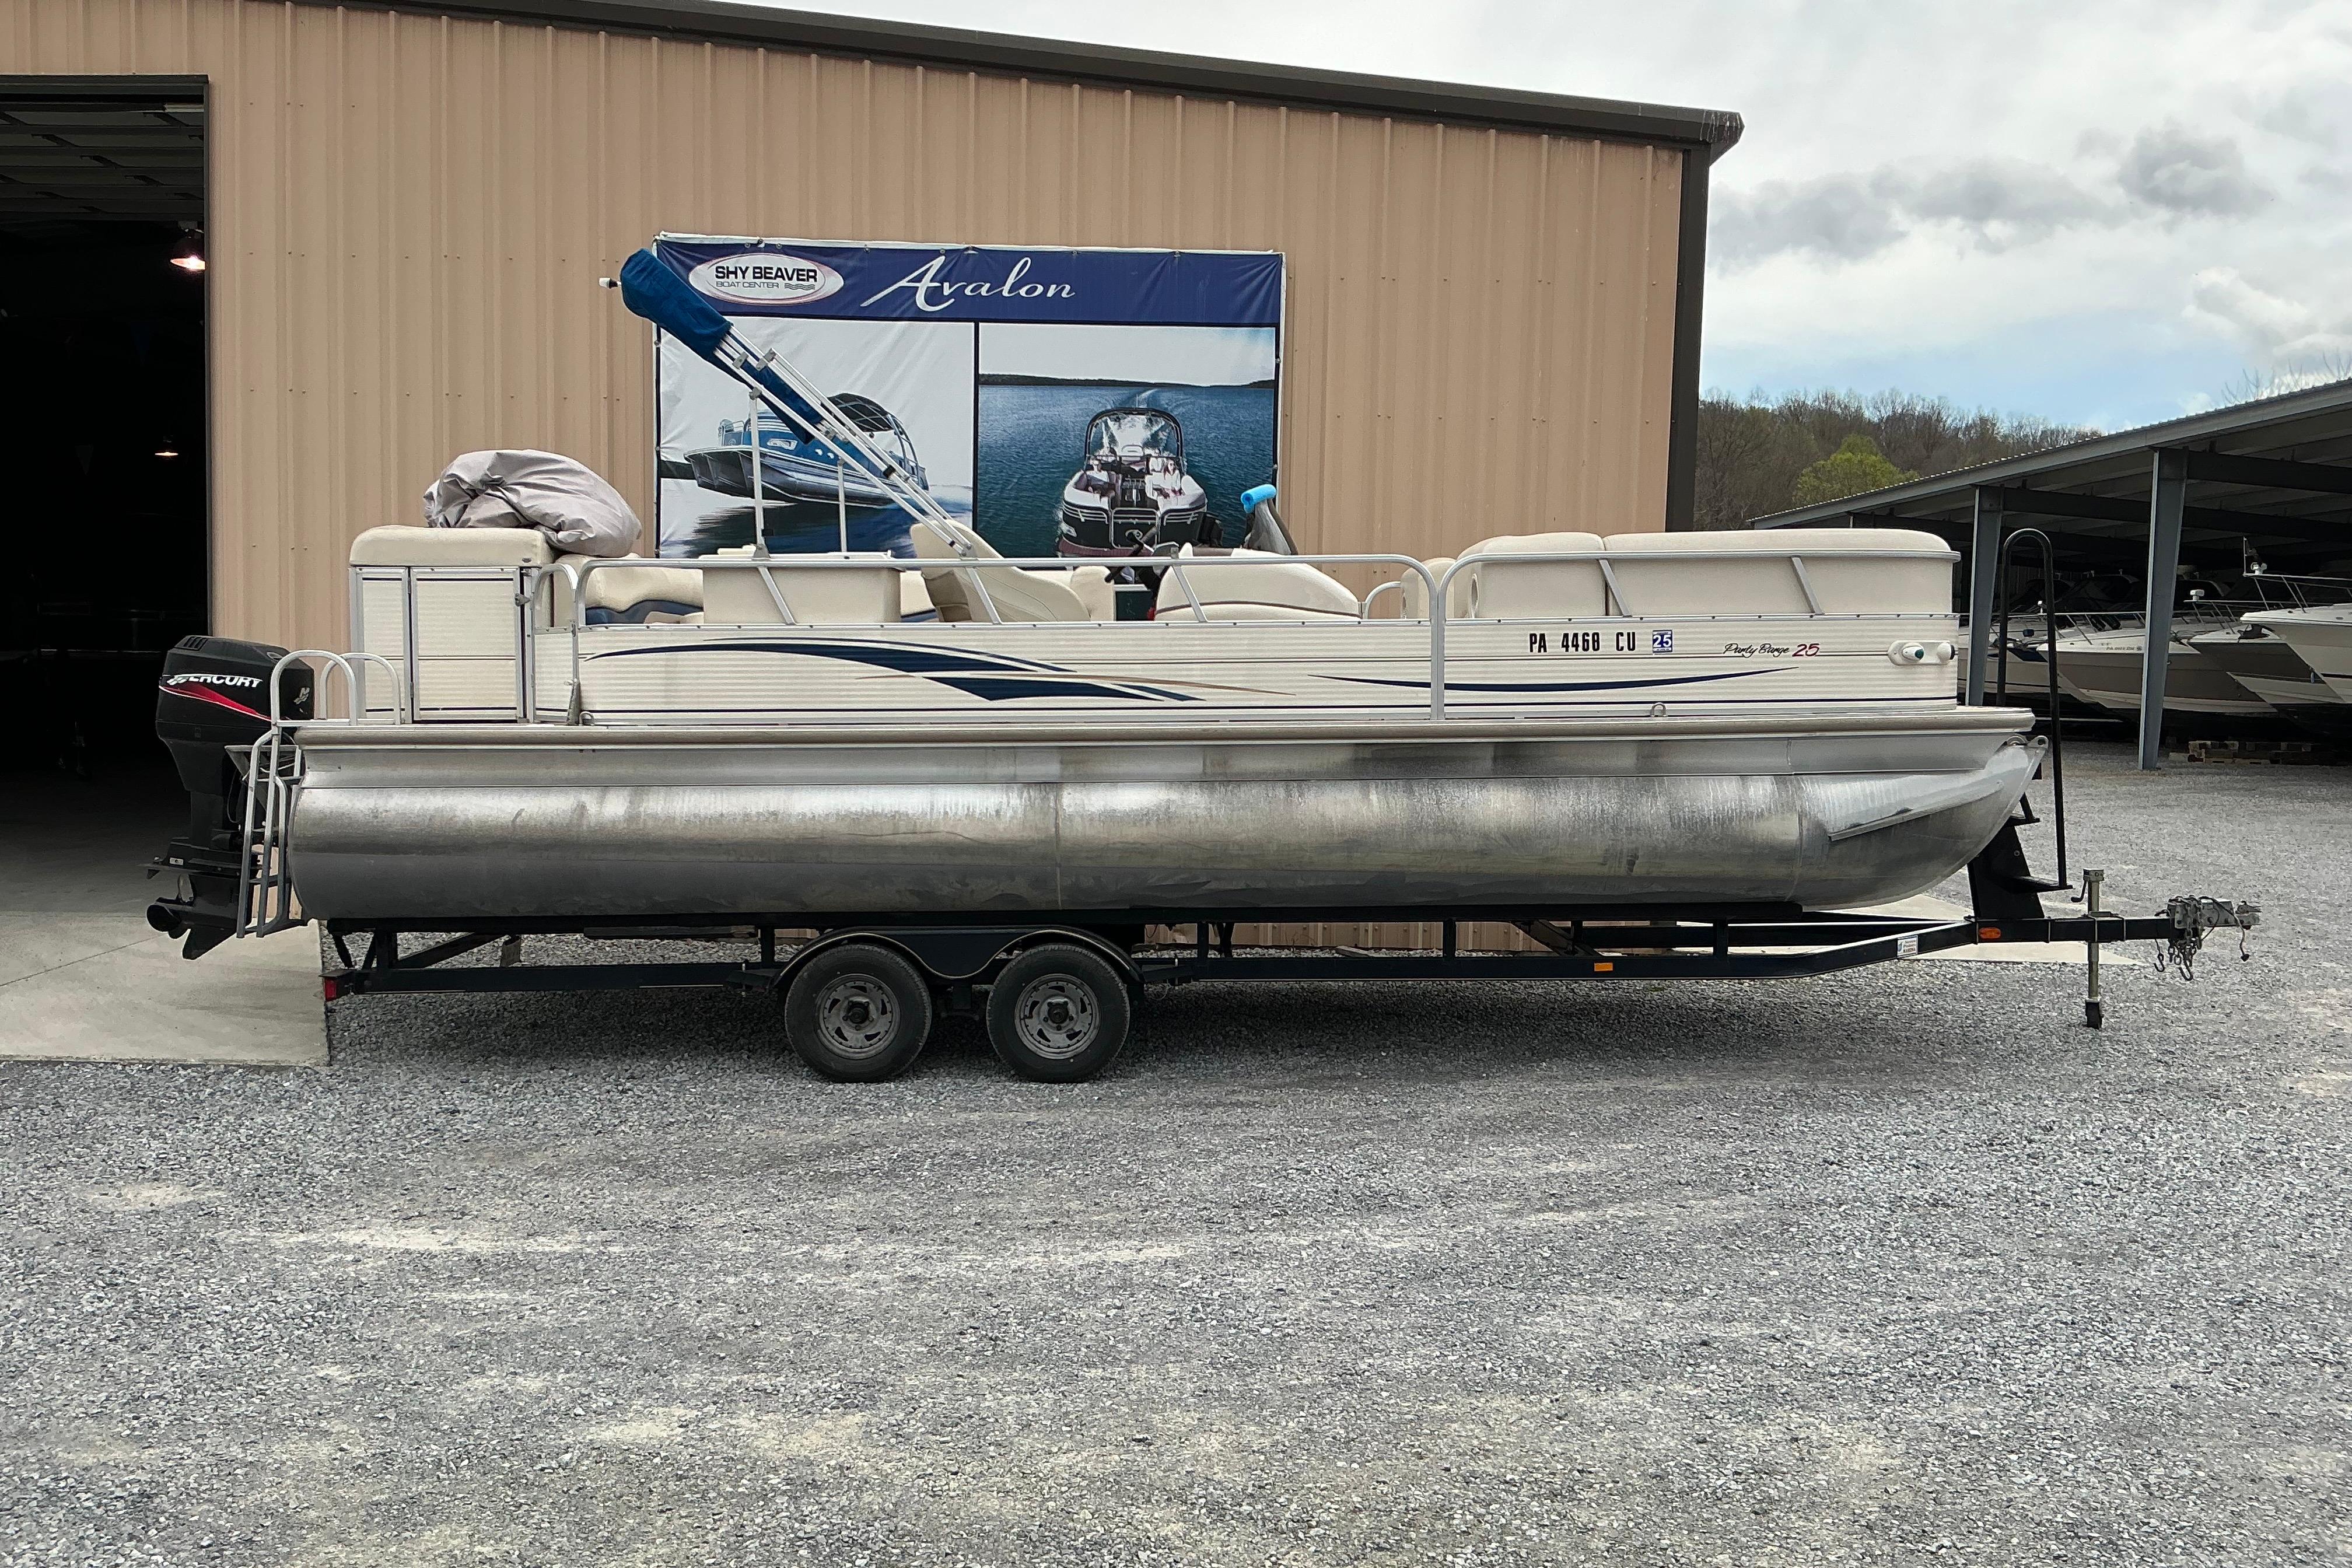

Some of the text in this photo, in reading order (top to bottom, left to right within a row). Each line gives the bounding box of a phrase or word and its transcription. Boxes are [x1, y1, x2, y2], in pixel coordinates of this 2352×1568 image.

[715, 265, 818, 283] SHY BEAVER
[860, 256, 1076, 312] Avalon
[1529, 631, 1636, 653] PA 4468 CU
[1653, 634, 1672, 648] 25
[1723, 643, 1820, 658] Party Barge 25
